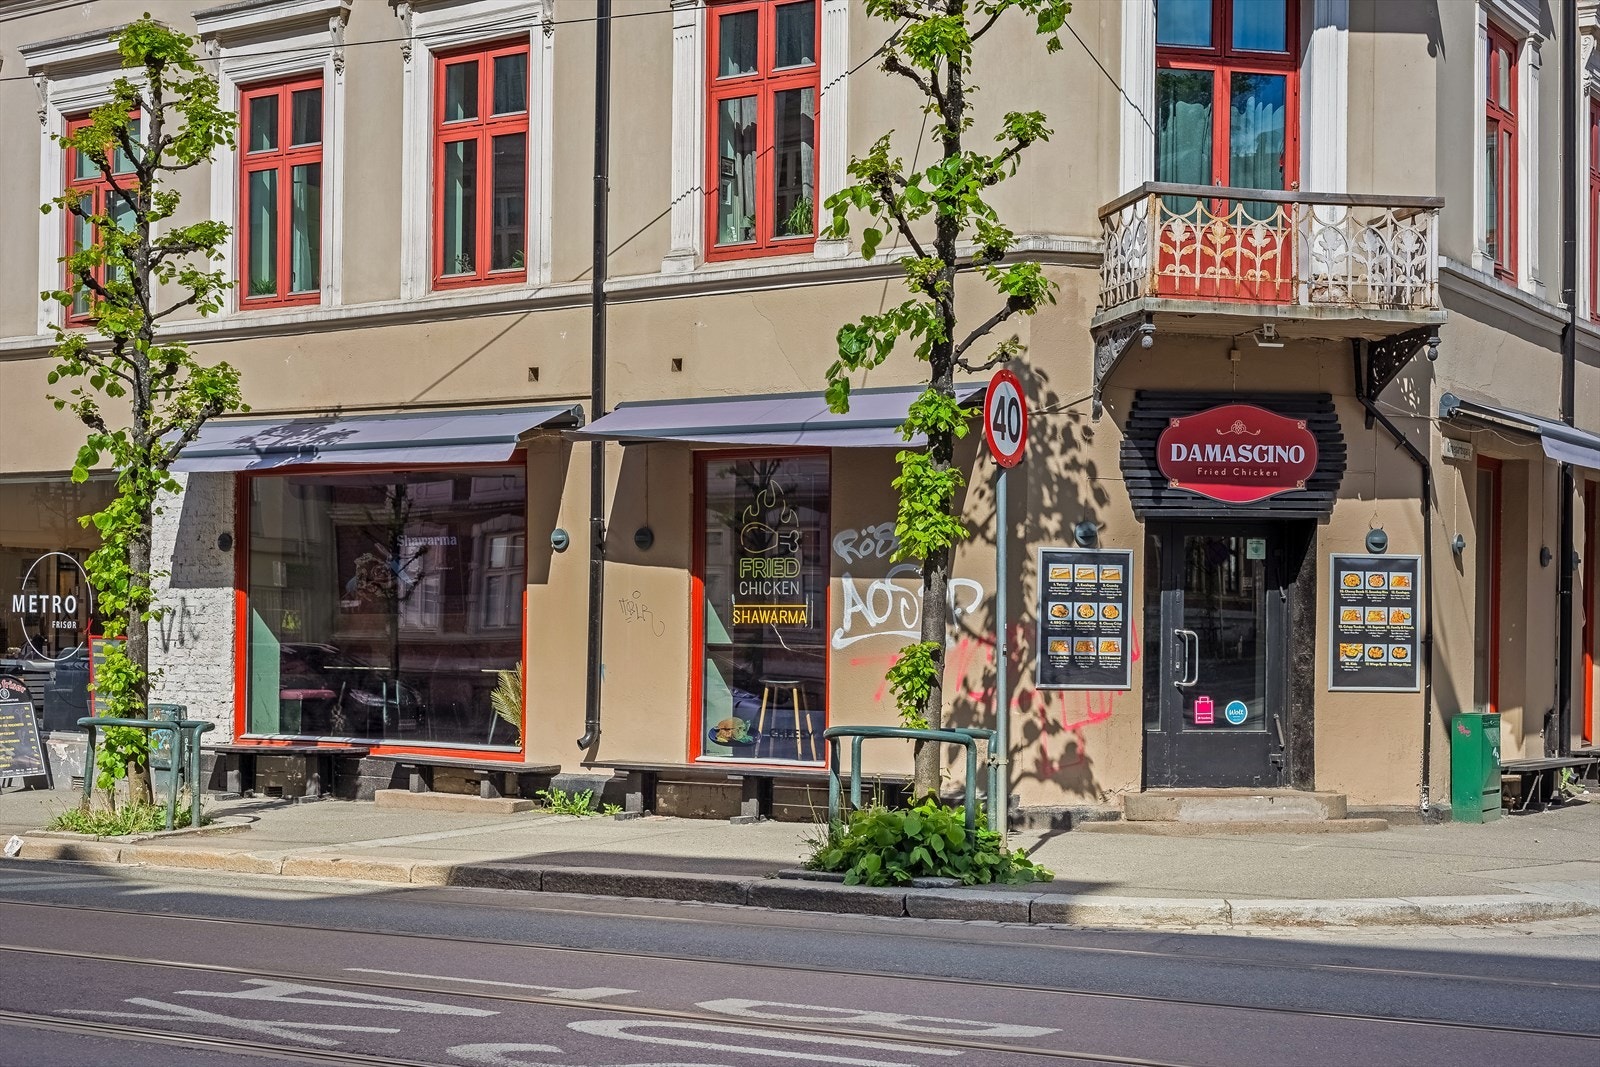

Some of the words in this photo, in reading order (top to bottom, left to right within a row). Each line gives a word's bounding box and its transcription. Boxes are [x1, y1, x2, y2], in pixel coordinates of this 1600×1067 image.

[993, 395, 1020, 443] 40
[1170, 443, 1305, 464] DAMASCINO
[1197, 467, 1227, 476] Fried
[1233, 467, 1278, 477] Chicken
[396, 534, 457, 547] Shawarma
[739, 557, 801, 578] FRIED
[739, 580, 800, 596] CHICKEN
[12, 594, 78, 615] METRO
[52, 620, 77, 630] FRISØR
[733, 608, 807, 625] SHAWARMA
